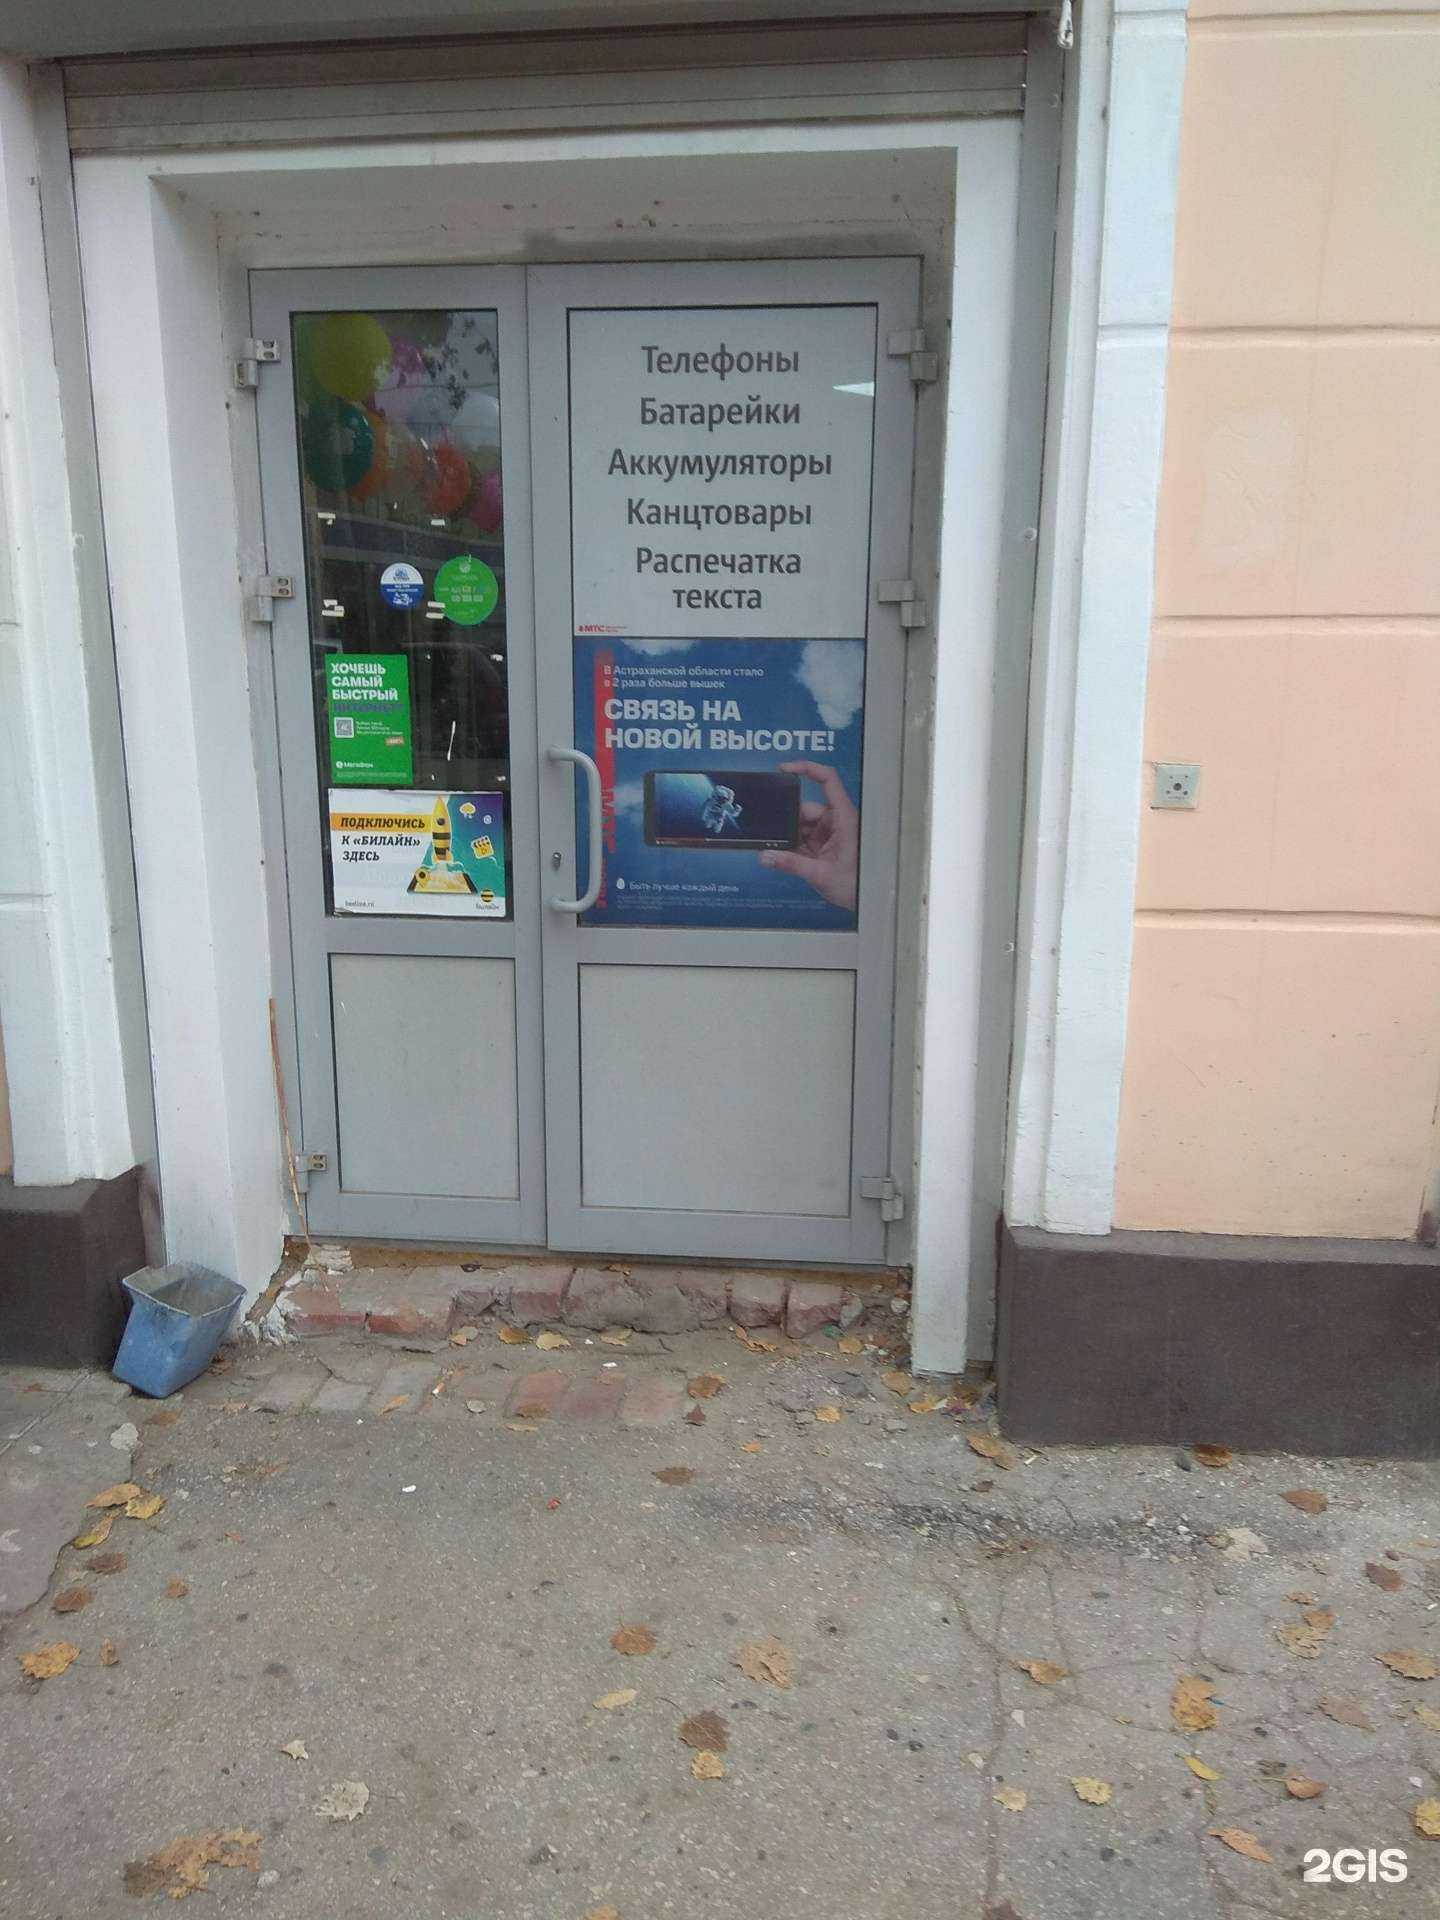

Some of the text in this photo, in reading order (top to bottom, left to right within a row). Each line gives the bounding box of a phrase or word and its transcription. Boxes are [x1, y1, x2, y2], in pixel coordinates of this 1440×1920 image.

[641, 342, 799, 381] Телефоны
[640, 395, 800, 432] Батарейки
[608, 448, 832, 483] Аккумуляторы
[627, 498, 812, 532] Канцтовары
[636, 547, 801, 575] Распечатка
[672, 588, 762, 610] текста
[331, 663, 386, 675] ХОЧЕШЬ
[603, 665, 765, 679] В Астраханской области стало
[331, 675, 383, 687] САМЫЙ
[612, 678, 620, 687] 2
[621, 679, 646, 689] раза
[648, 678, 688, 688] больше
[332, 688, 399, 701] БЫСТРЫЙ
[604, 699, 742, 722] СВЯЗЬ НА
[605, 723, 835, 751] НОВОЙ ВЫСОТЕ!
[340, 816, 426, 830] ПОДКЛЮЧИСЬ
[341, 833, 421, 847] К «БИЛАЙН»
[342, 851, 380, 862] ЗДЕСЬ
